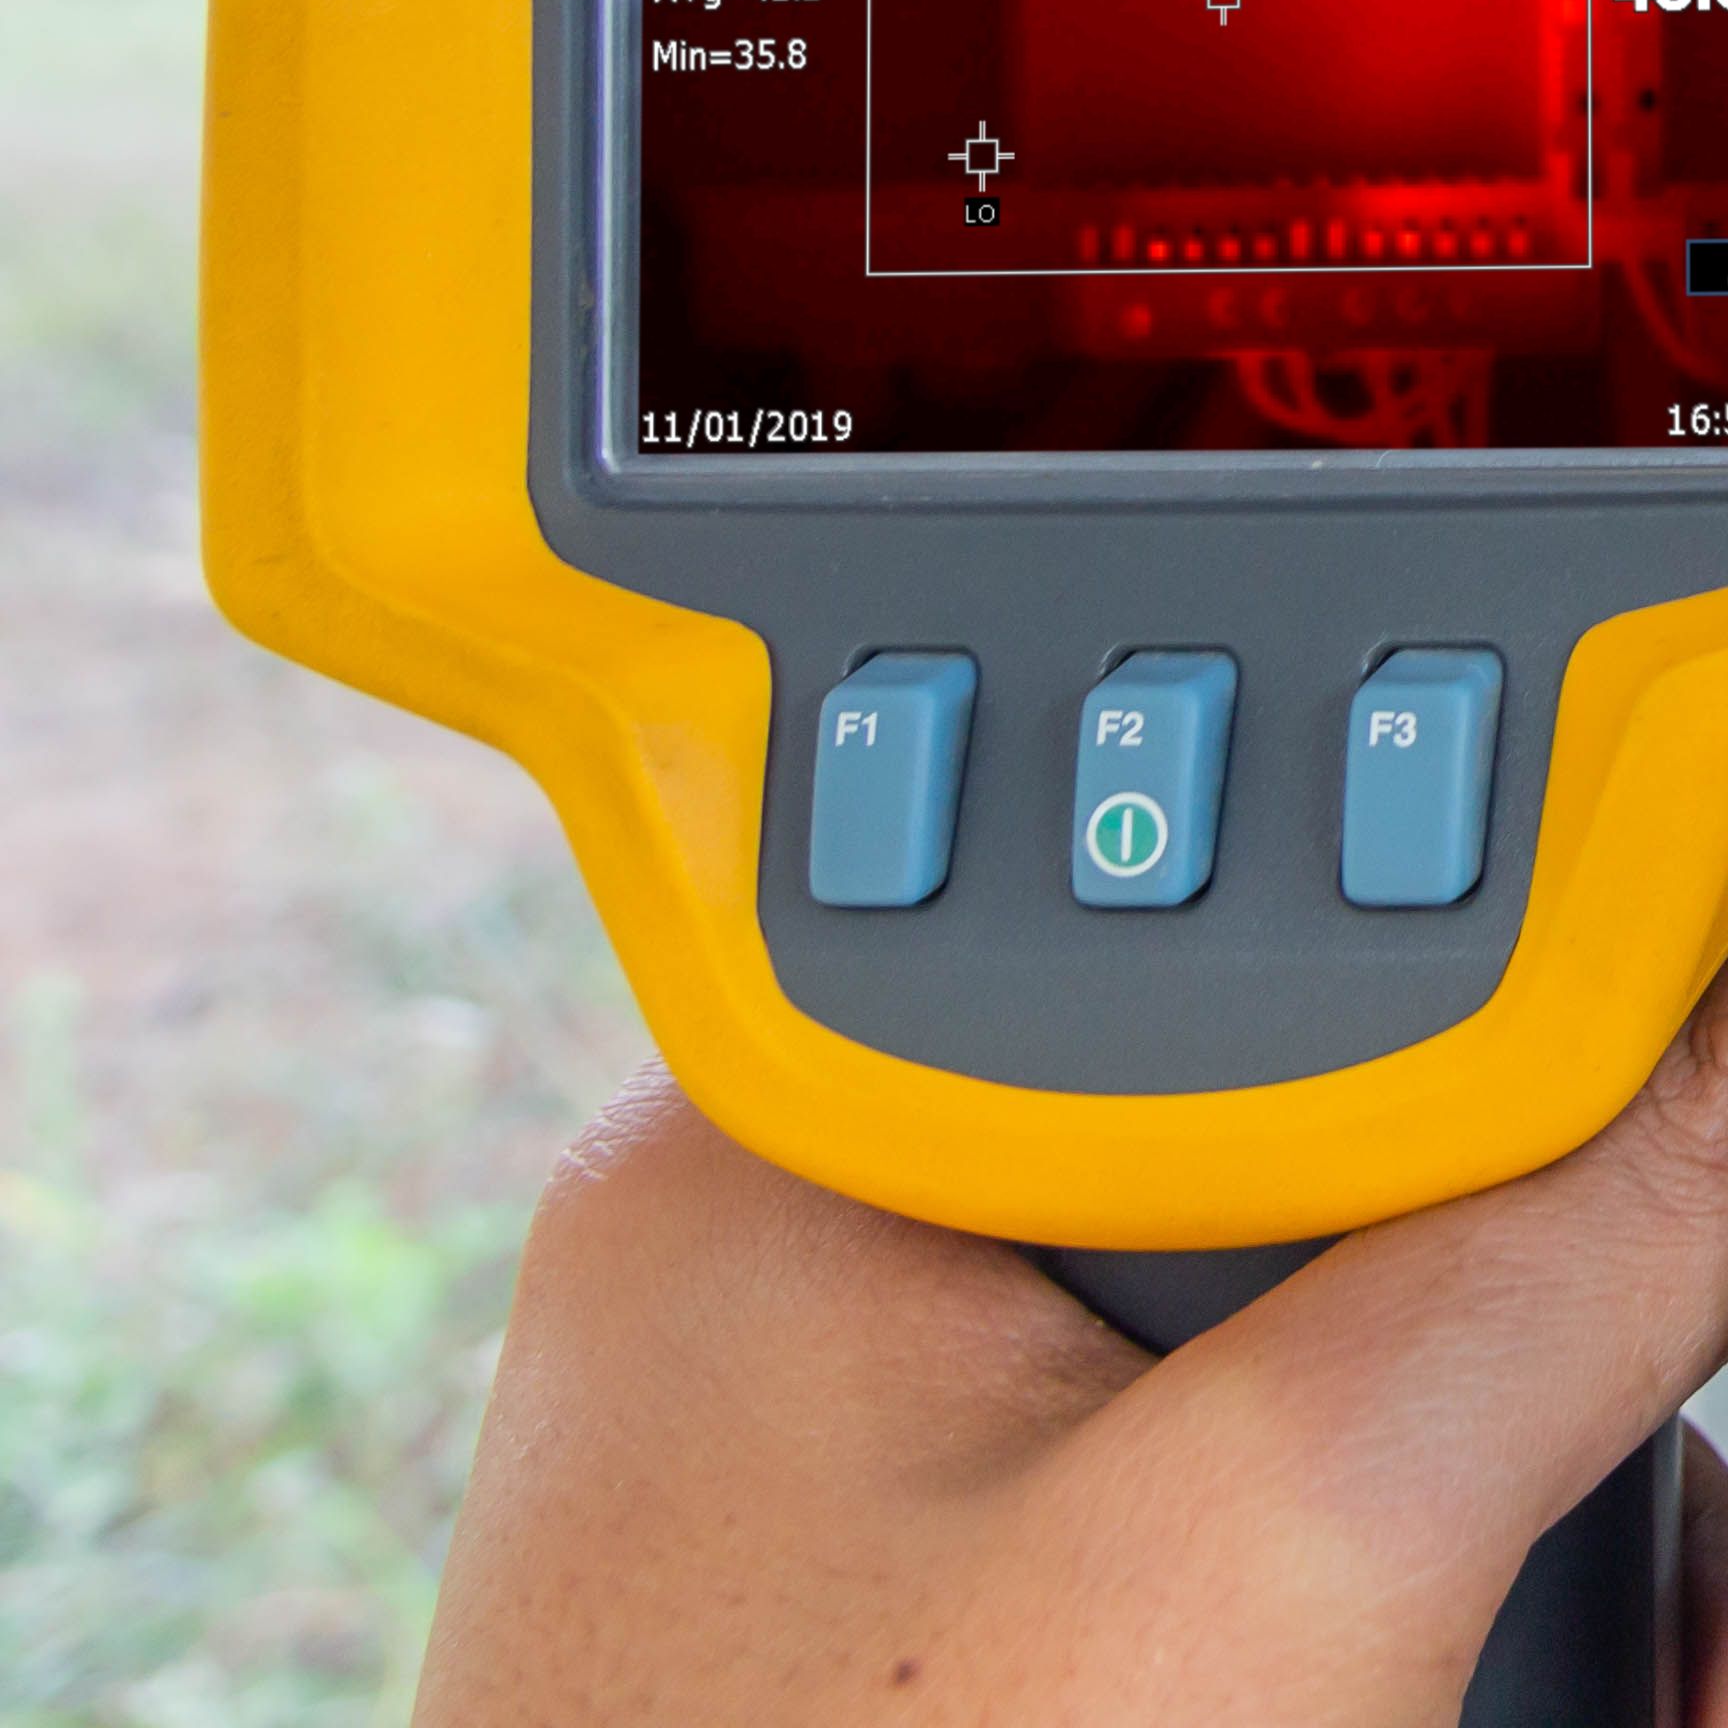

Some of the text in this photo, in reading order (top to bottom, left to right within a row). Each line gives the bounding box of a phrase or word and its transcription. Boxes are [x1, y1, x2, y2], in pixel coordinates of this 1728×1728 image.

[653, 38, 808, 72] Min=35.8
[964, 203, 996, 225] LO
[642, 408, 853, 448] 11/01/2019
[834, 710, 879, 747] F1
[1095, 710, 1144, 747] F2
[1368, 711, 1417, 748] F3
